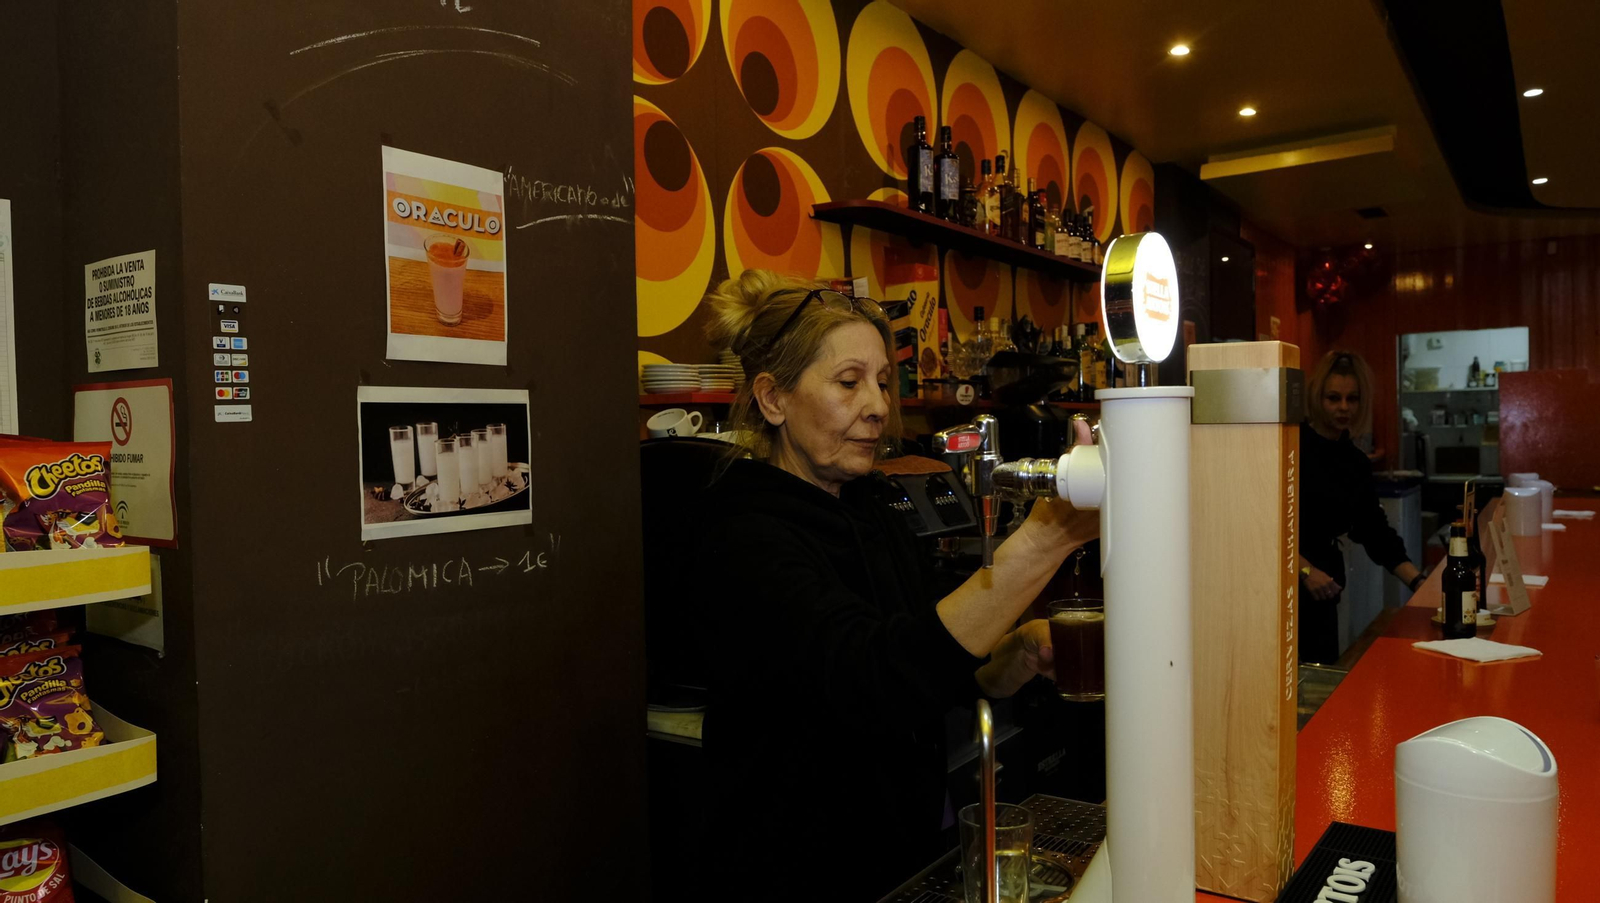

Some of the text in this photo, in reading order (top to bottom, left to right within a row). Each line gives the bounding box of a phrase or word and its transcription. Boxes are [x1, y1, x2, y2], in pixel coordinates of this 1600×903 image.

[393, 198, 501, 234] ORACULO
[92, 259, 145, 281] PROHIBIDA LA VENTA
[103, 275, 135, 292] SUMINISTRO
[87, 297, 94, 309] DE
[95, 293, 112, 308] BEBIDAS
[90, 299, 149, 322] A MENORES DE 18 AÑOS
[126, 454, 144, 463] FUMAR
[27, 453, 104, 498] Cheetos
[65, 480, 106, 493] Pandilla
[1285, 449, 1294, 701] CERVEZAS ALHAMBRA
[0, 658, 63, 708] heetos
[20, 680, 67, 701] Pandilla
[49, 873, 66, 889] SAL
